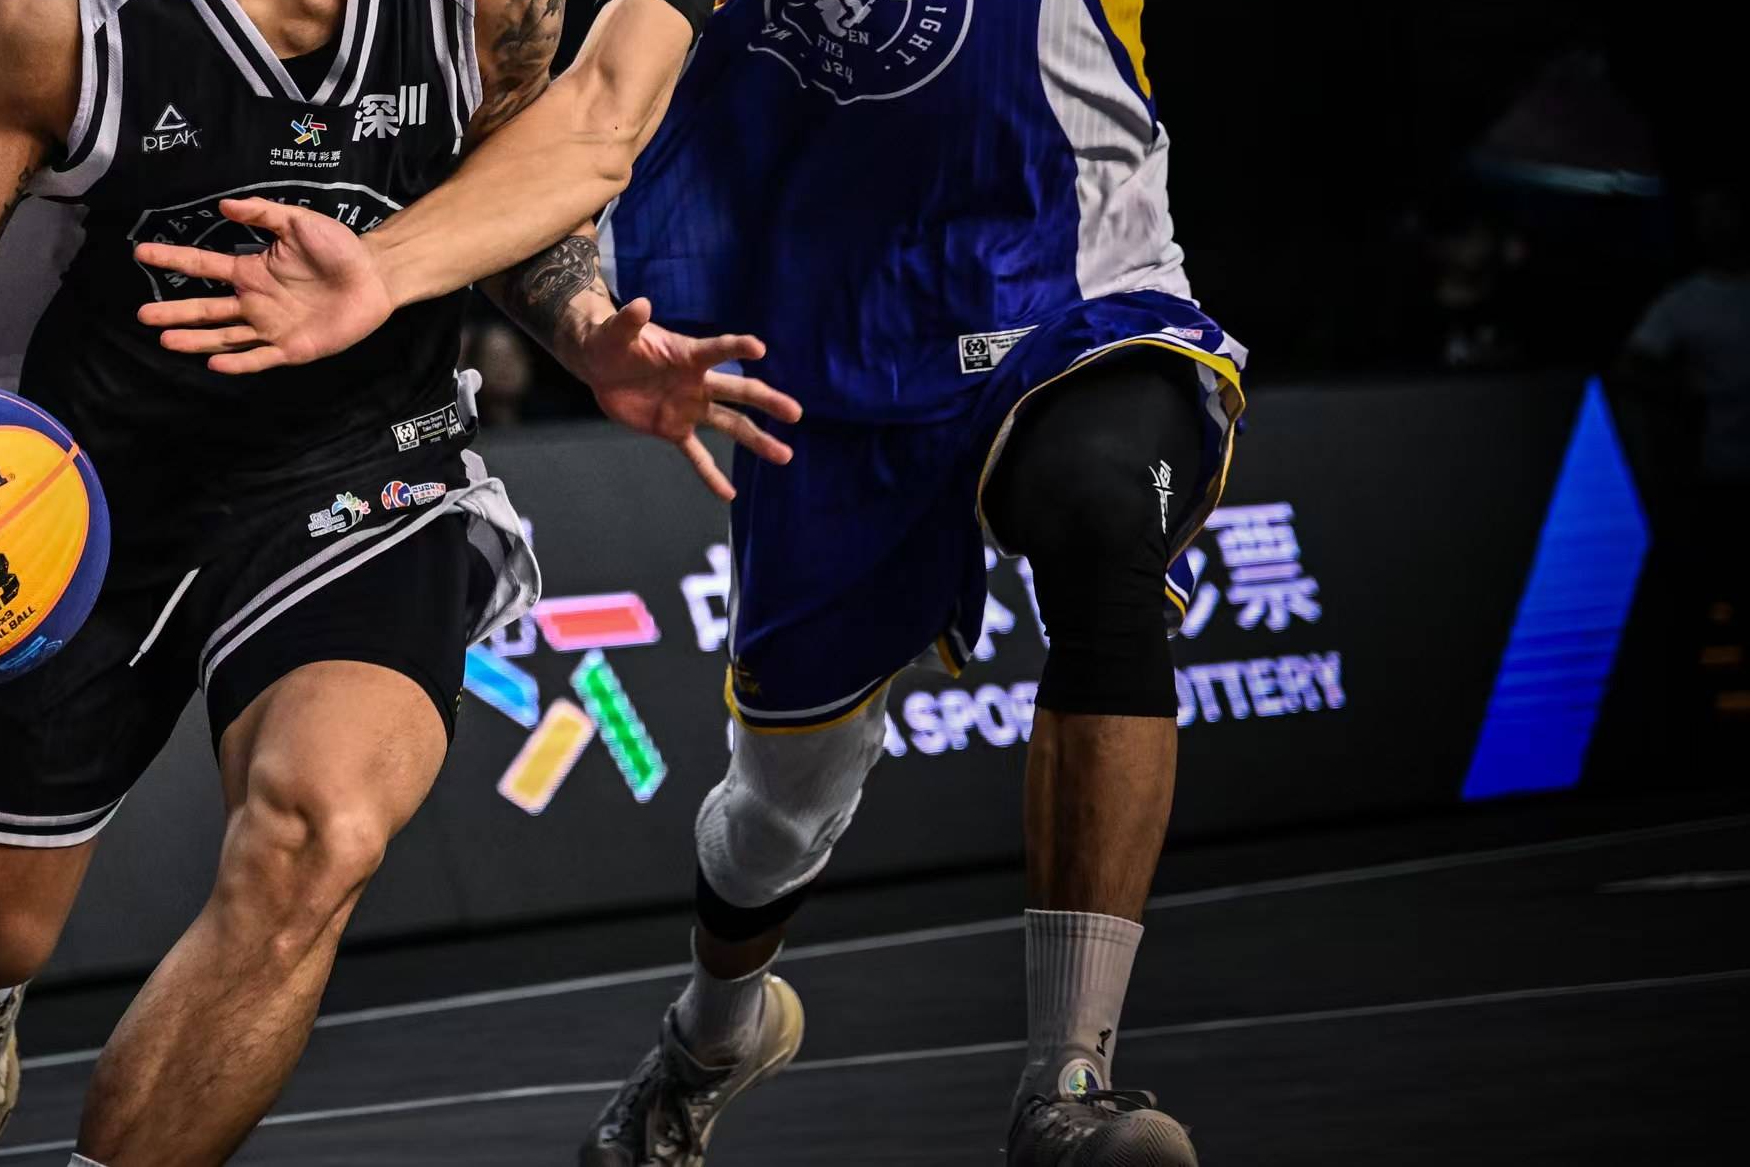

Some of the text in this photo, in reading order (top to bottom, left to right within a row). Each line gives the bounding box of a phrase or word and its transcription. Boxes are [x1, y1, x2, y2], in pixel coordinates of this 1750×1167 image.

[142, 130, 199, 154] PEAK
[270, 148, 342, 162] 中国体育彩票
[335, 202, 382, 233] TAK
[8, 605, 36, 631] BALL
